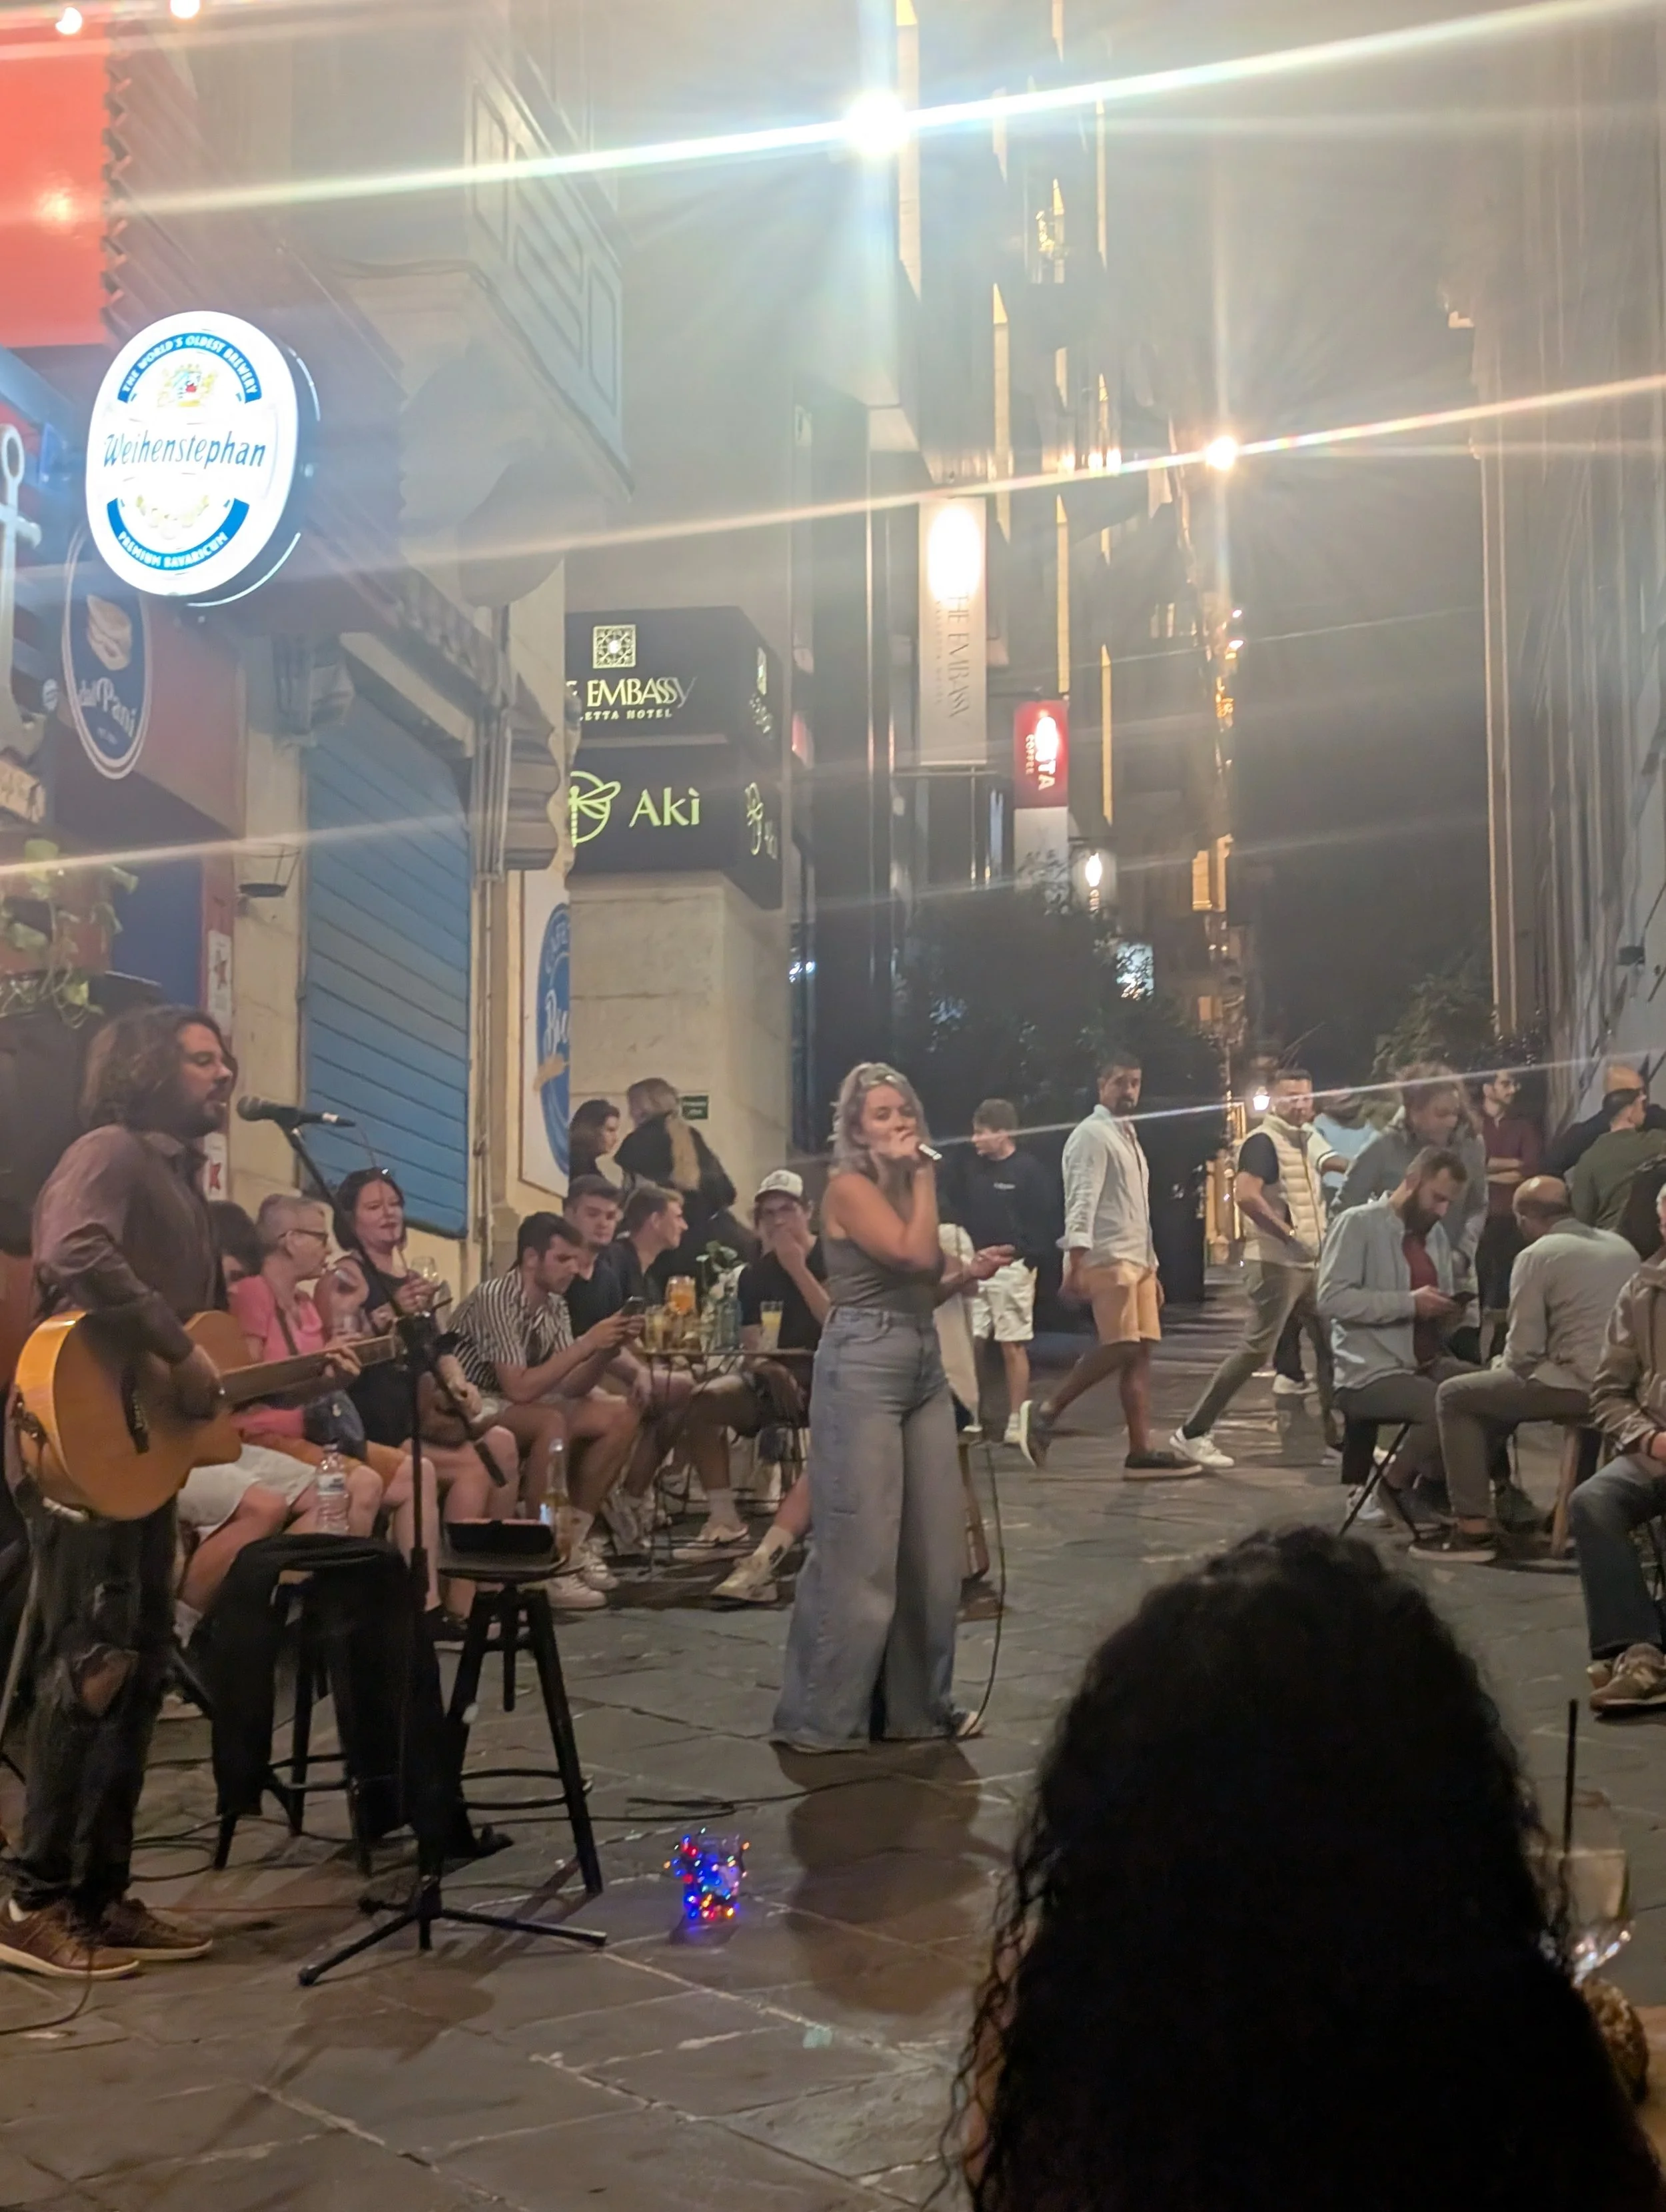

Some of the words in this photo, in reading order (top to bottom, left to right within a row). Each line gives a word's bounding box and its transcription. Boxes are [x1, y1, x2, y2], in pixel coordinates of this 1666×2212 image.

[122, 370, 139, 392] THE
[137, 336, 183, 370] WORLD'S
[185, 335, 227, 353] OLDEST
[223, 348, 258, 393] BREWERY
[104, 430, 267, 470] Weihenstephan
[118, 531, 161, 566] PREMIUM
[164, 532, 228, 568] BAVARICUM
[587, 676, 698, 708] EMBASSY
[579, 710, 620, 721] ETTA
[626, 709, 672, 720] HOTEL
[1026, 734, 1035, 775] COFFEE
